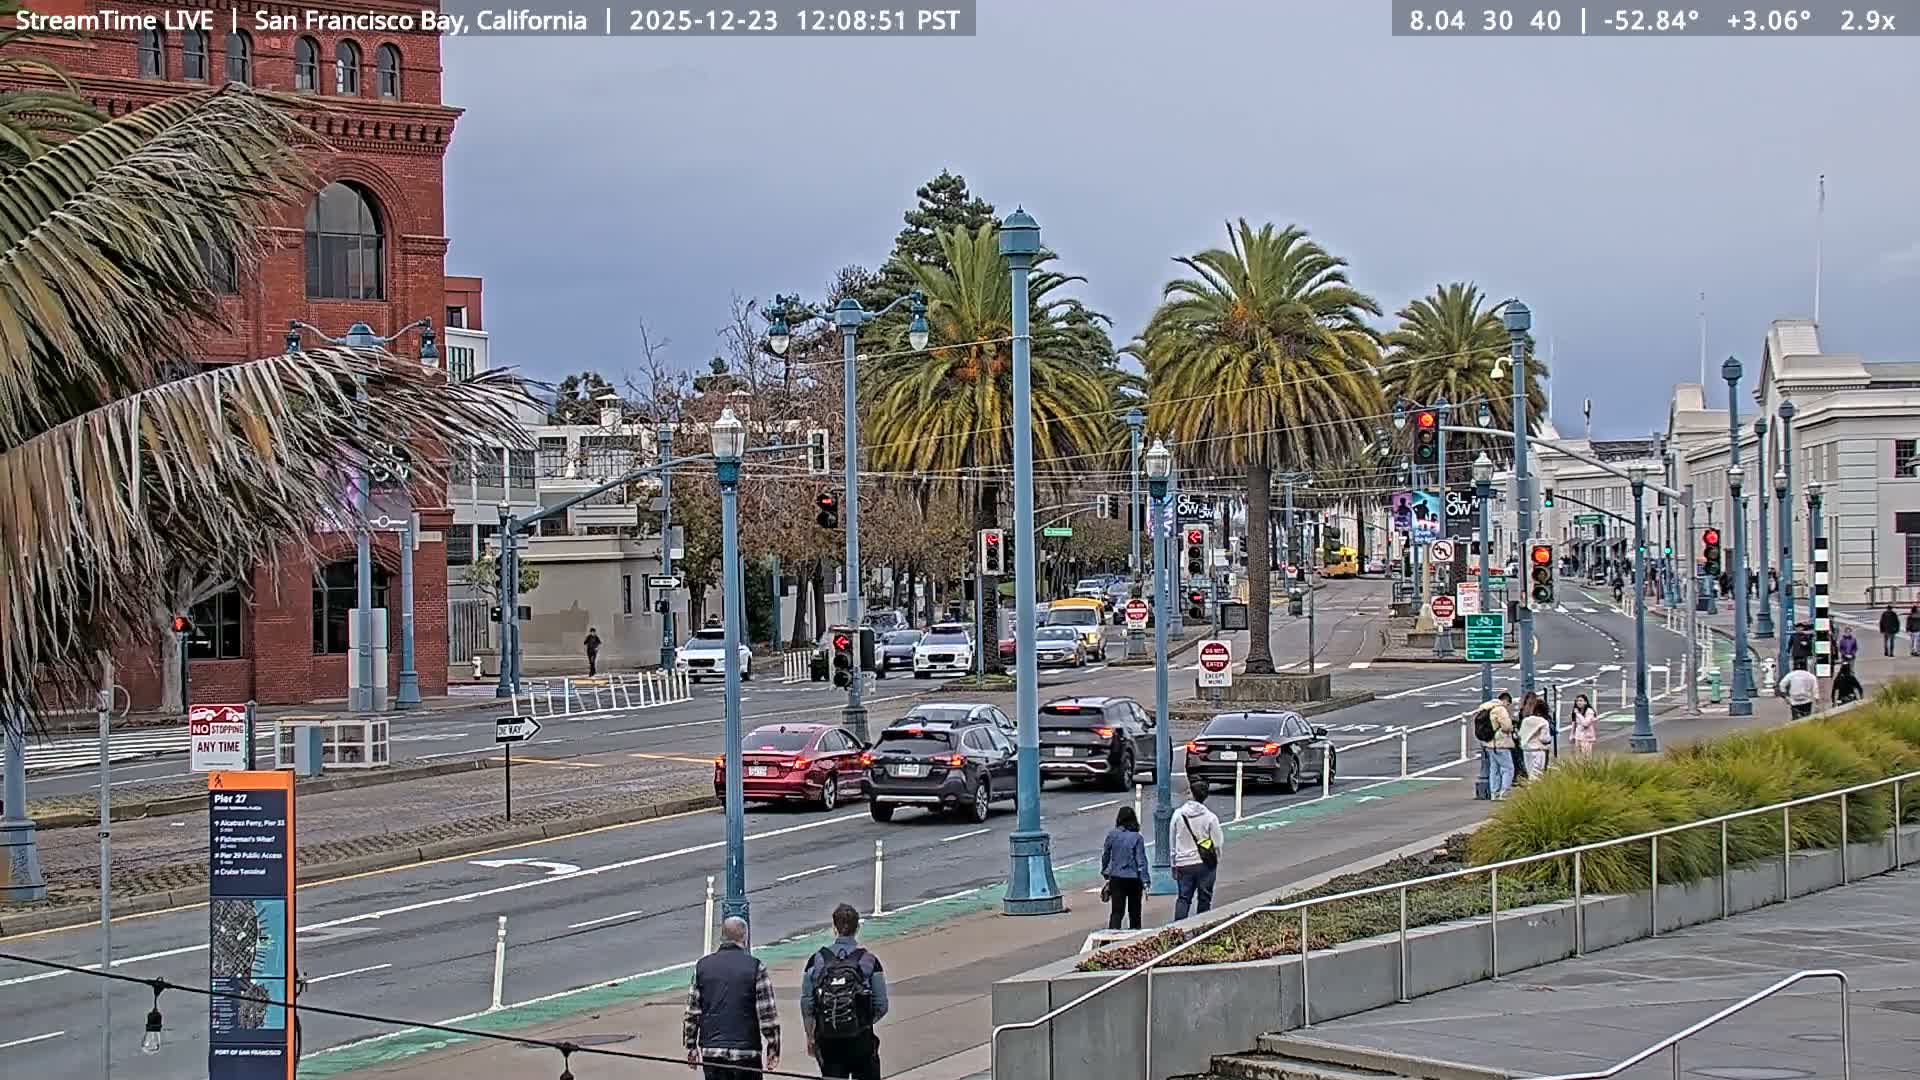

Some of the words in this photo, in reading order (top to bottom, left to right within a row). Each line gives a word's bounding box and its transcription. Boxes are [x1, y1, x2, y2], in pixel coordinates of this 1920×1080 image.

[192, 724, 209, 734] NO
[197, 741, 216, 753] ANY
[218, 741, 240, 753] TIME
[214, 794, 233, 804] Pier
[235, 794, 247, 804] 27
